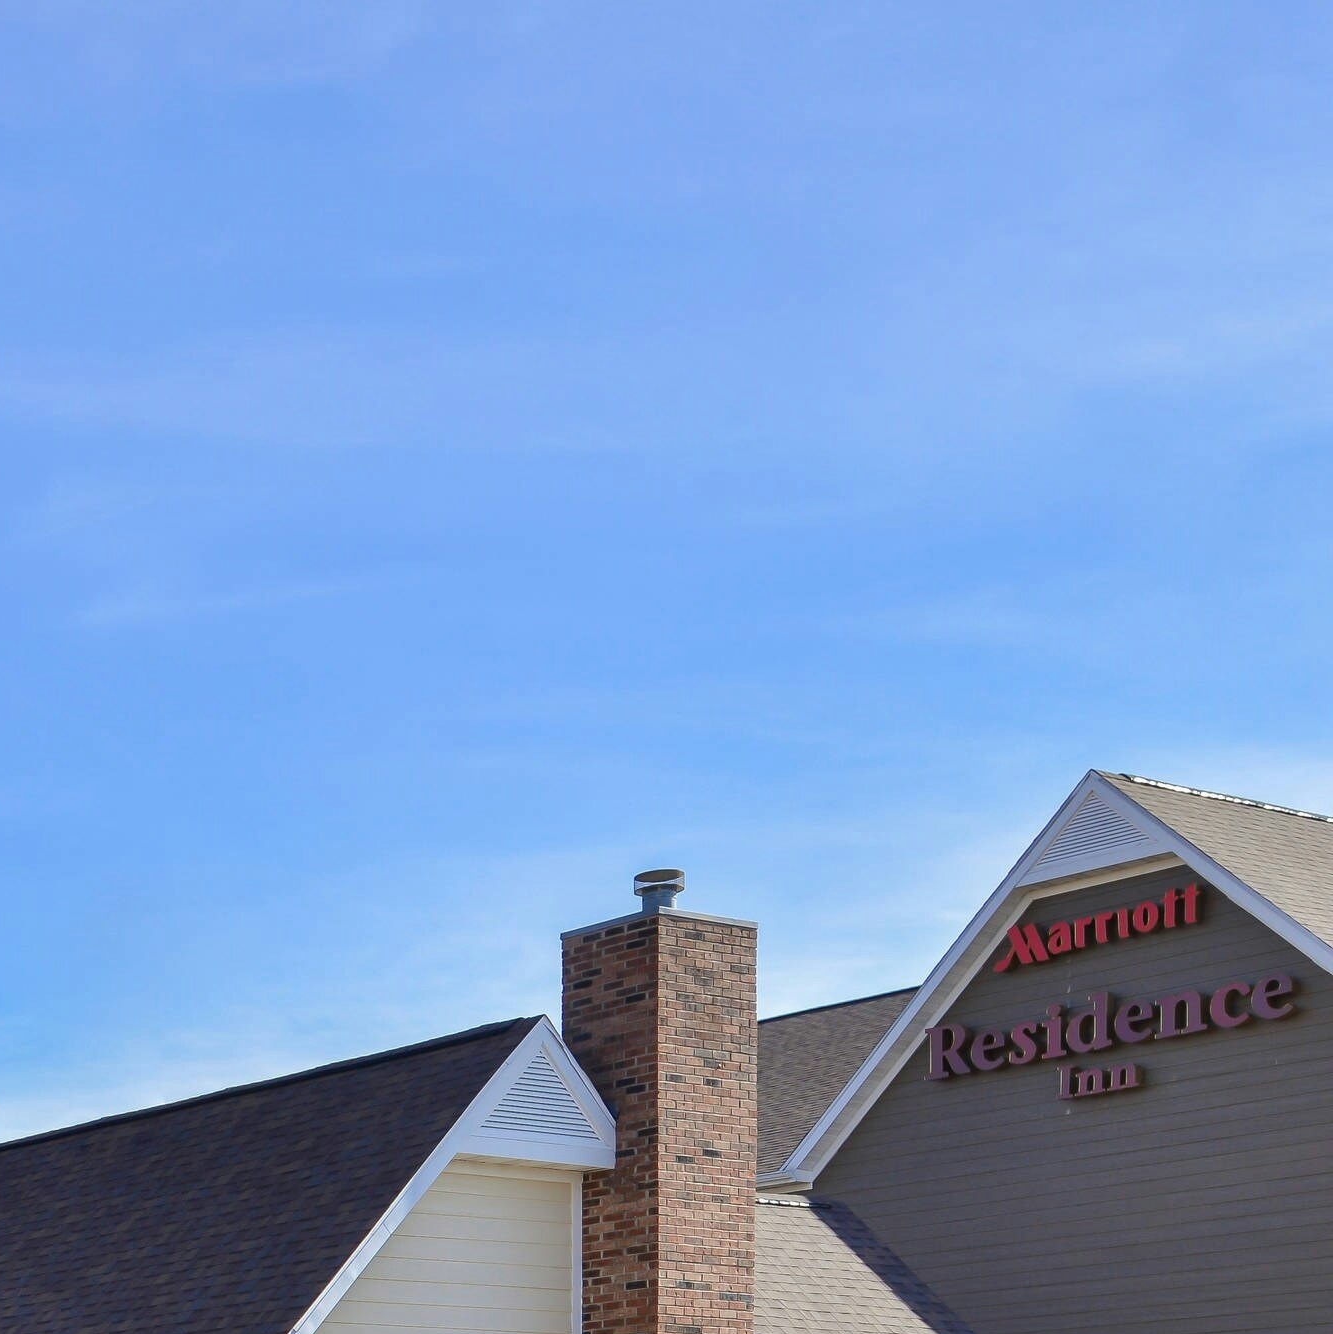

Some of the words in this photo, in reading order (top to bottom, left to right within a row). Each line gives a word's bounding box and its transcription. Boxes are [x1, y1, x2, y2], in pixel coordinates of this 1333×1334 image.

[994, 882, 1201, 972] Marriott
[923, 973, 1295, 1080] Residence
[1055, 1062, 1140, 1099] Inn
